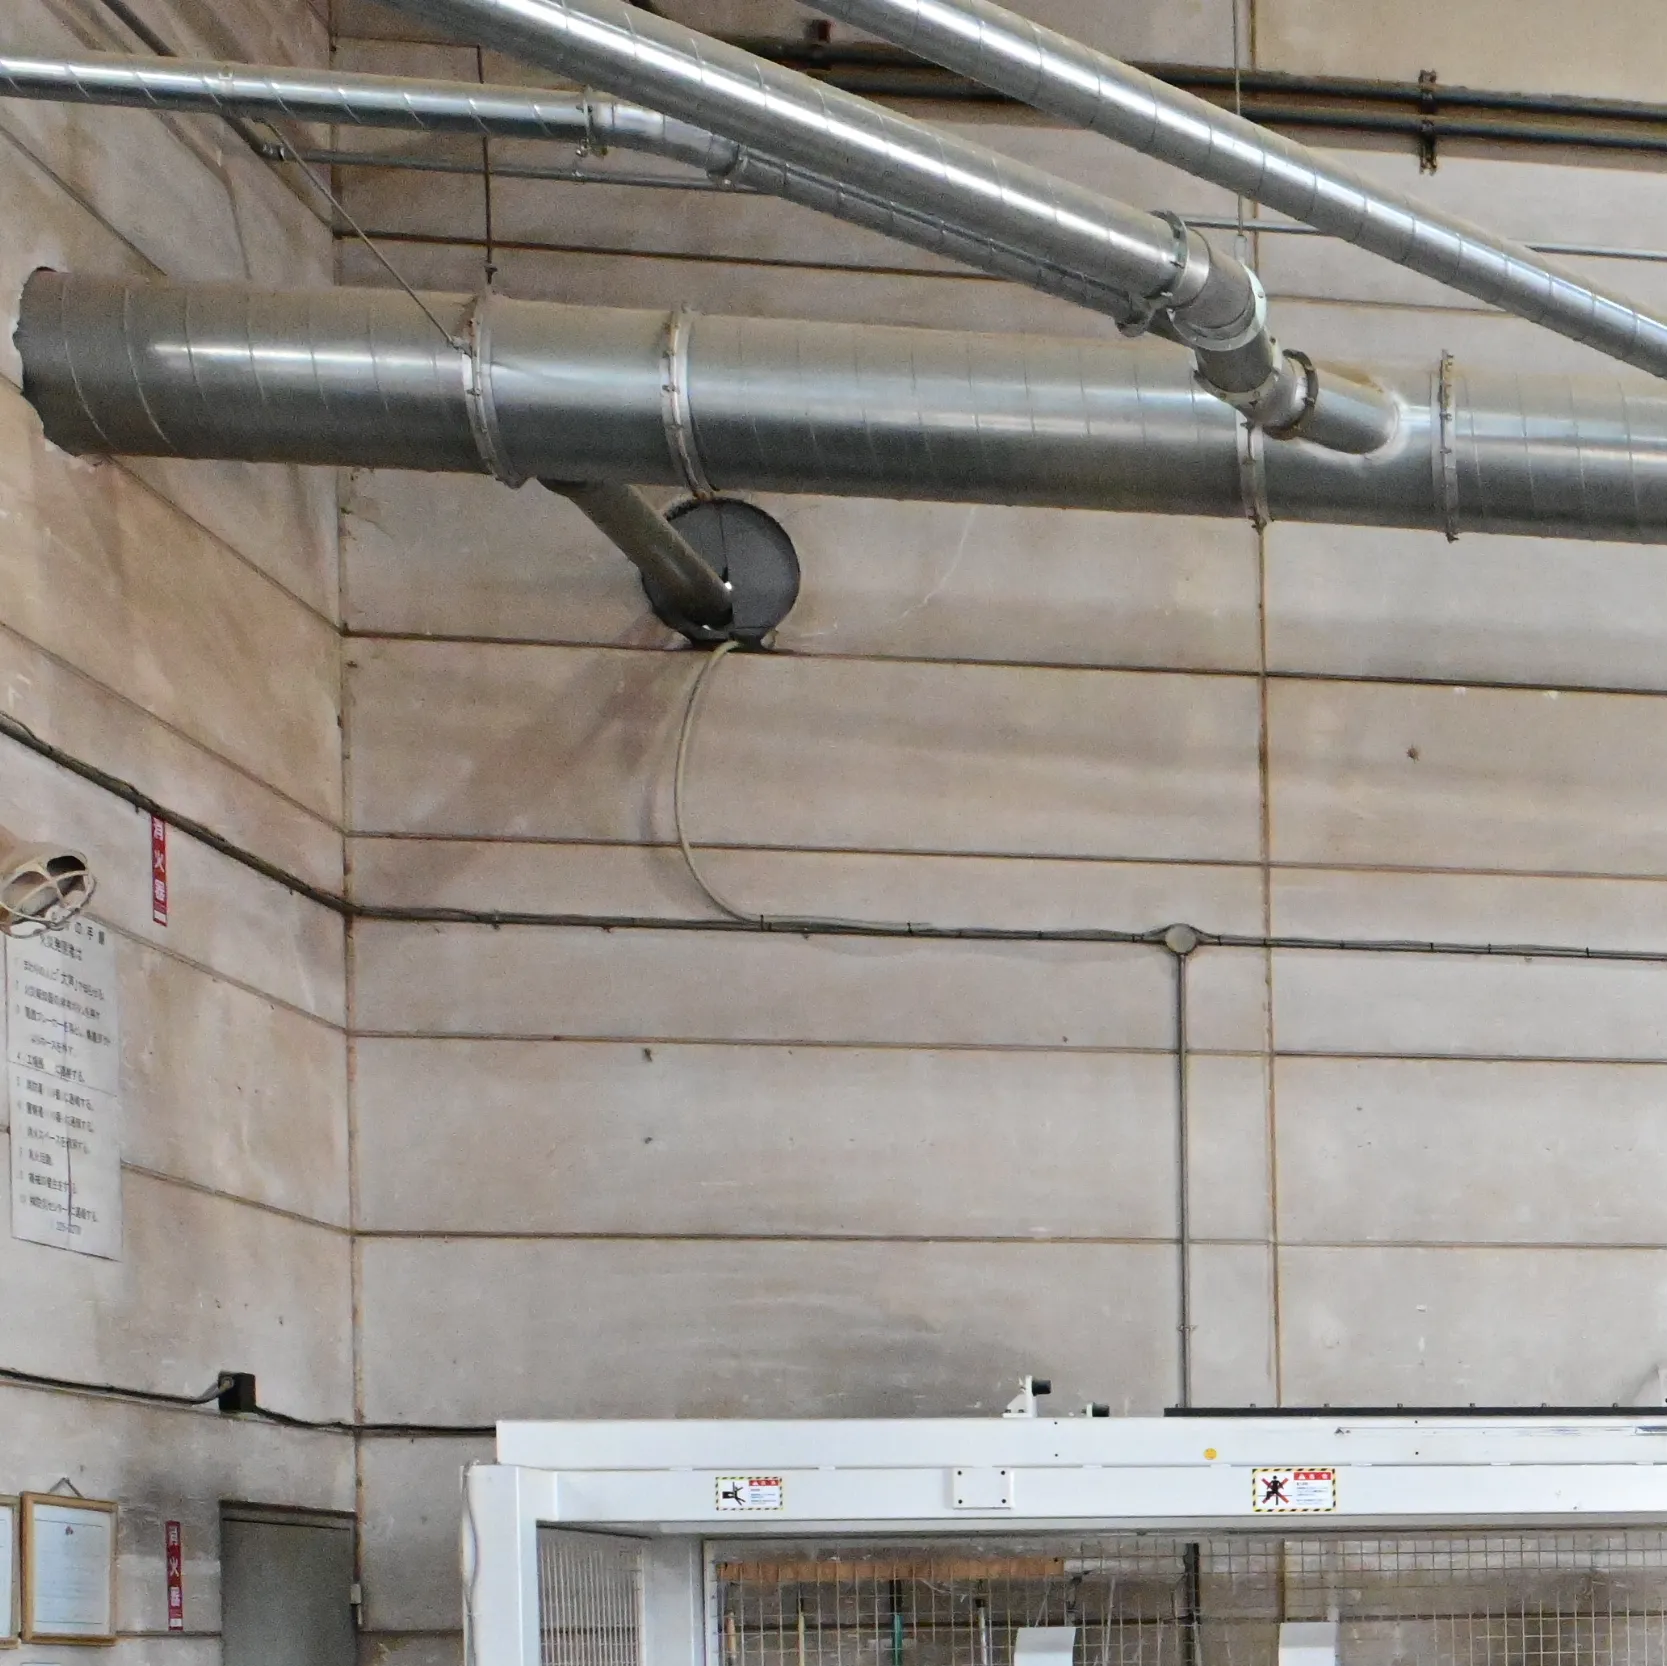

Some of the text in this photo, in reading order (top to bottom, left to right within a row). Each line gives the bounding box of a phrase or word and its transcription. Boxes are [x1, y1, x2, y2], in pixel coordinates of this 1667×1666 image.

[153, 817, 165, 901] 消火器
[168, 1525, 180, 1607] 消火器
